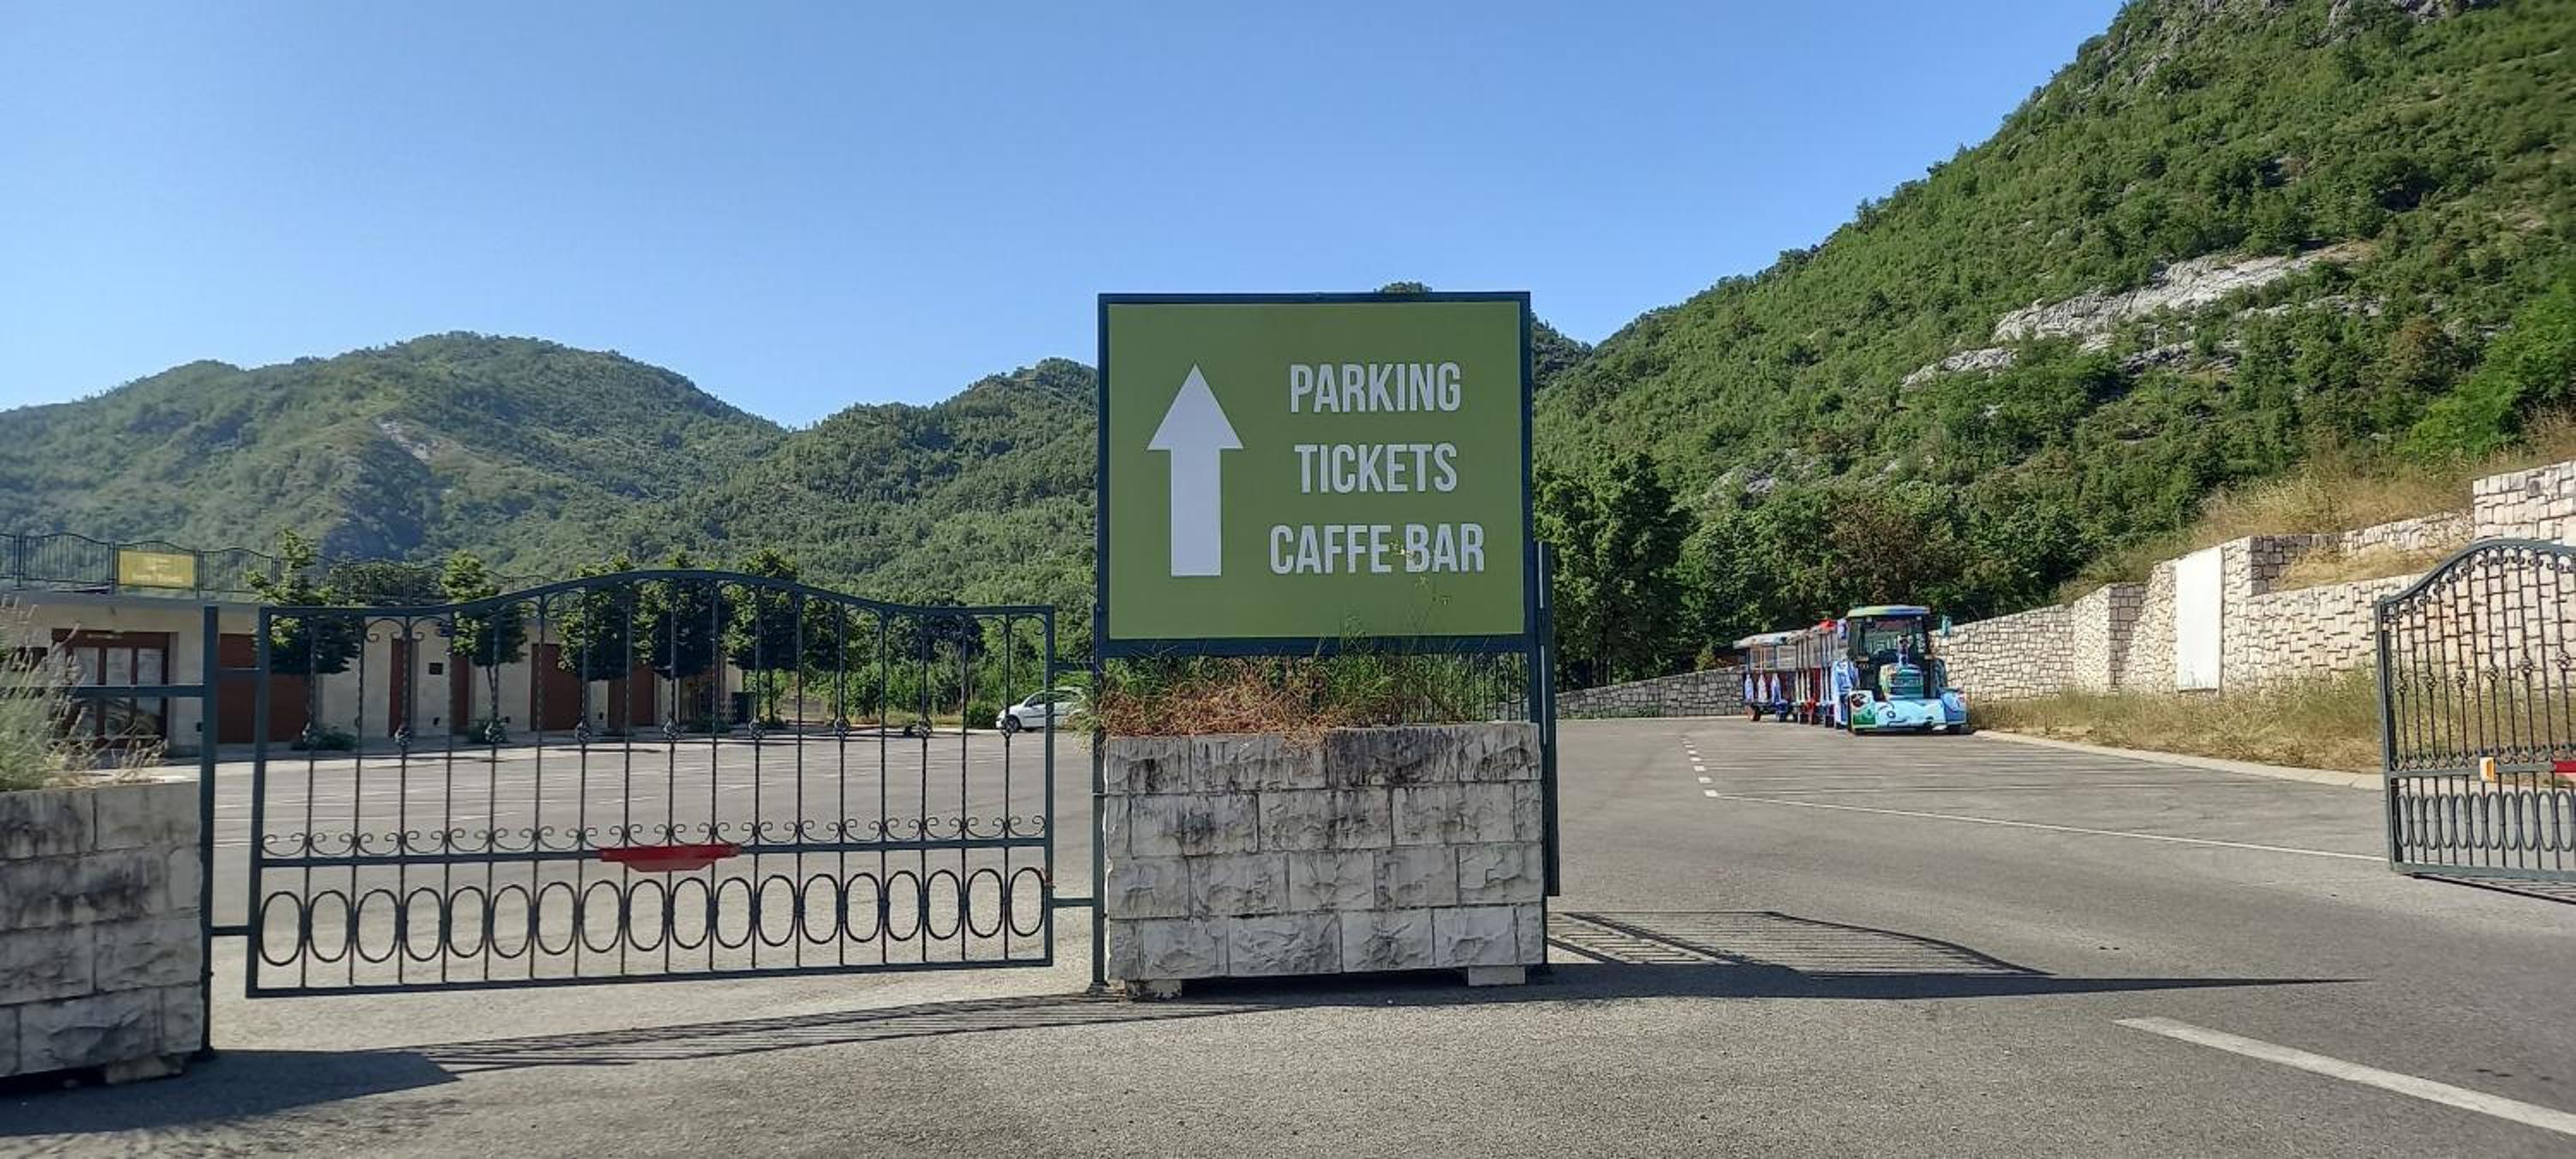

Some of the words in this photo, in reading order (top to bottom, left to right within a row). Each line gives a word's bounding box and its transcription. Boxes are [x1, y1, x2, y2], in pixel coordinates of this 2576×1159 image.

[1291, 362, 1461, 413] PARKING
[1294, 443, 1457, 494] TICKETS
[1270, 525, 1392, 574] CAFFE
[1405, 523, 1485, 573] BAR
